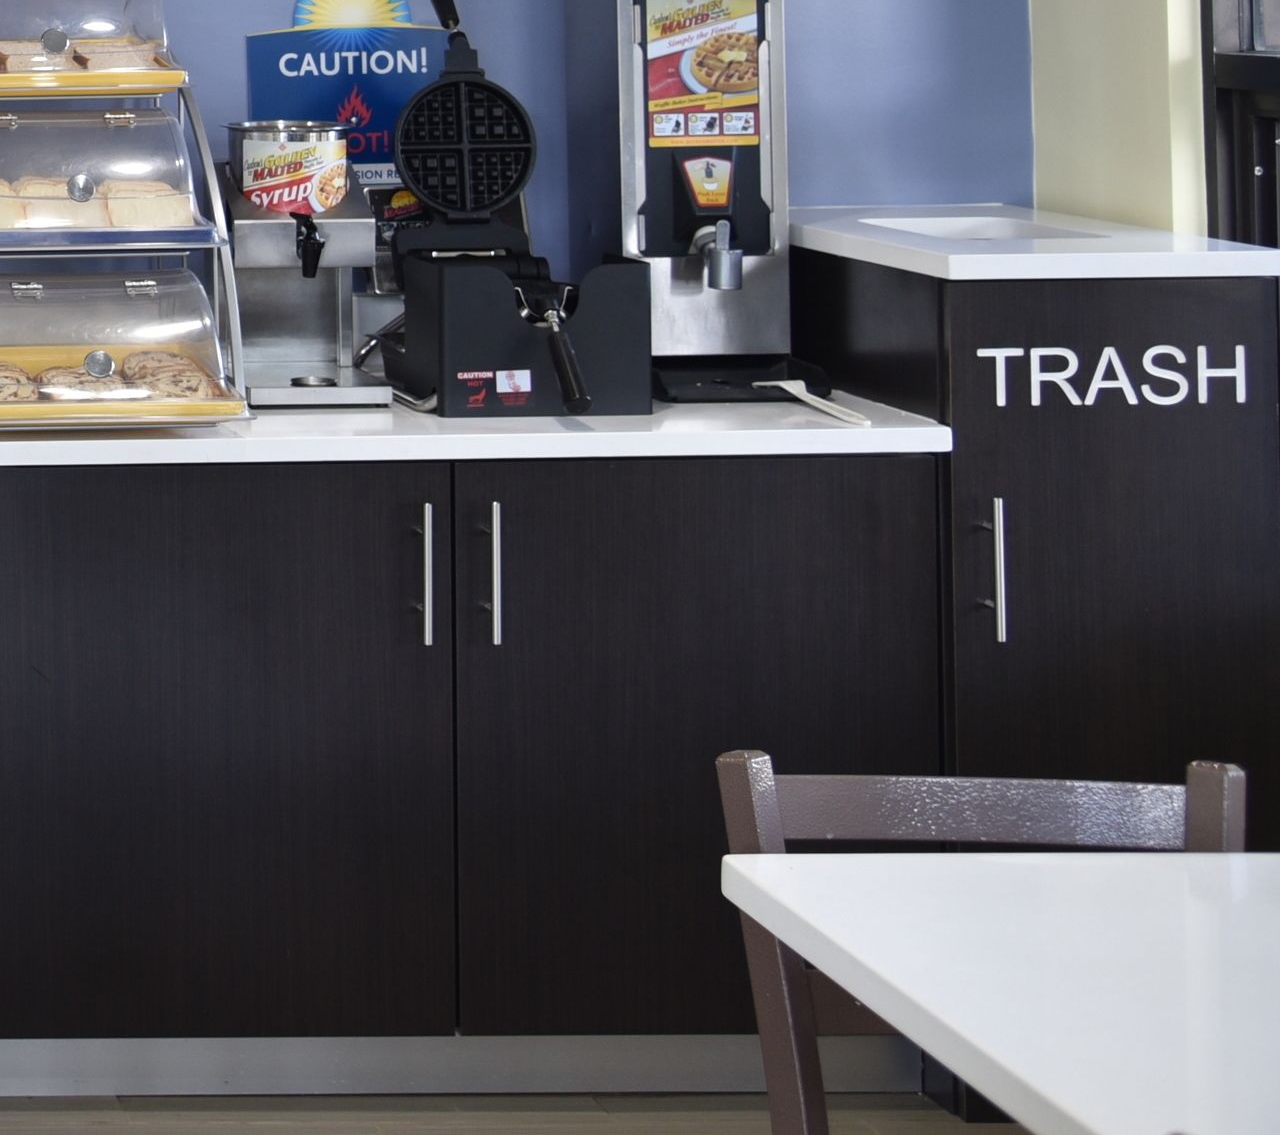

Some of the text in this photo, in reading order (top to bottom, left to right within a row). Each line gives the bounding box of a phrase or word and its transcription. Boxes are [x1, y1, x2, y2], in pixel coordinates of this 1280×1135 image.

[661, 12, 710, 35] MALTED
[278, 47, 428, 77] CAUTION!
[347, 130, 391, 153] OT!
[252, 161, 304, 182] MALTED
[250, 181, 312, 209] Syrup
[457, 371, 493, 379] CAUTION
[976, 344, 1247, 407] TRASH
